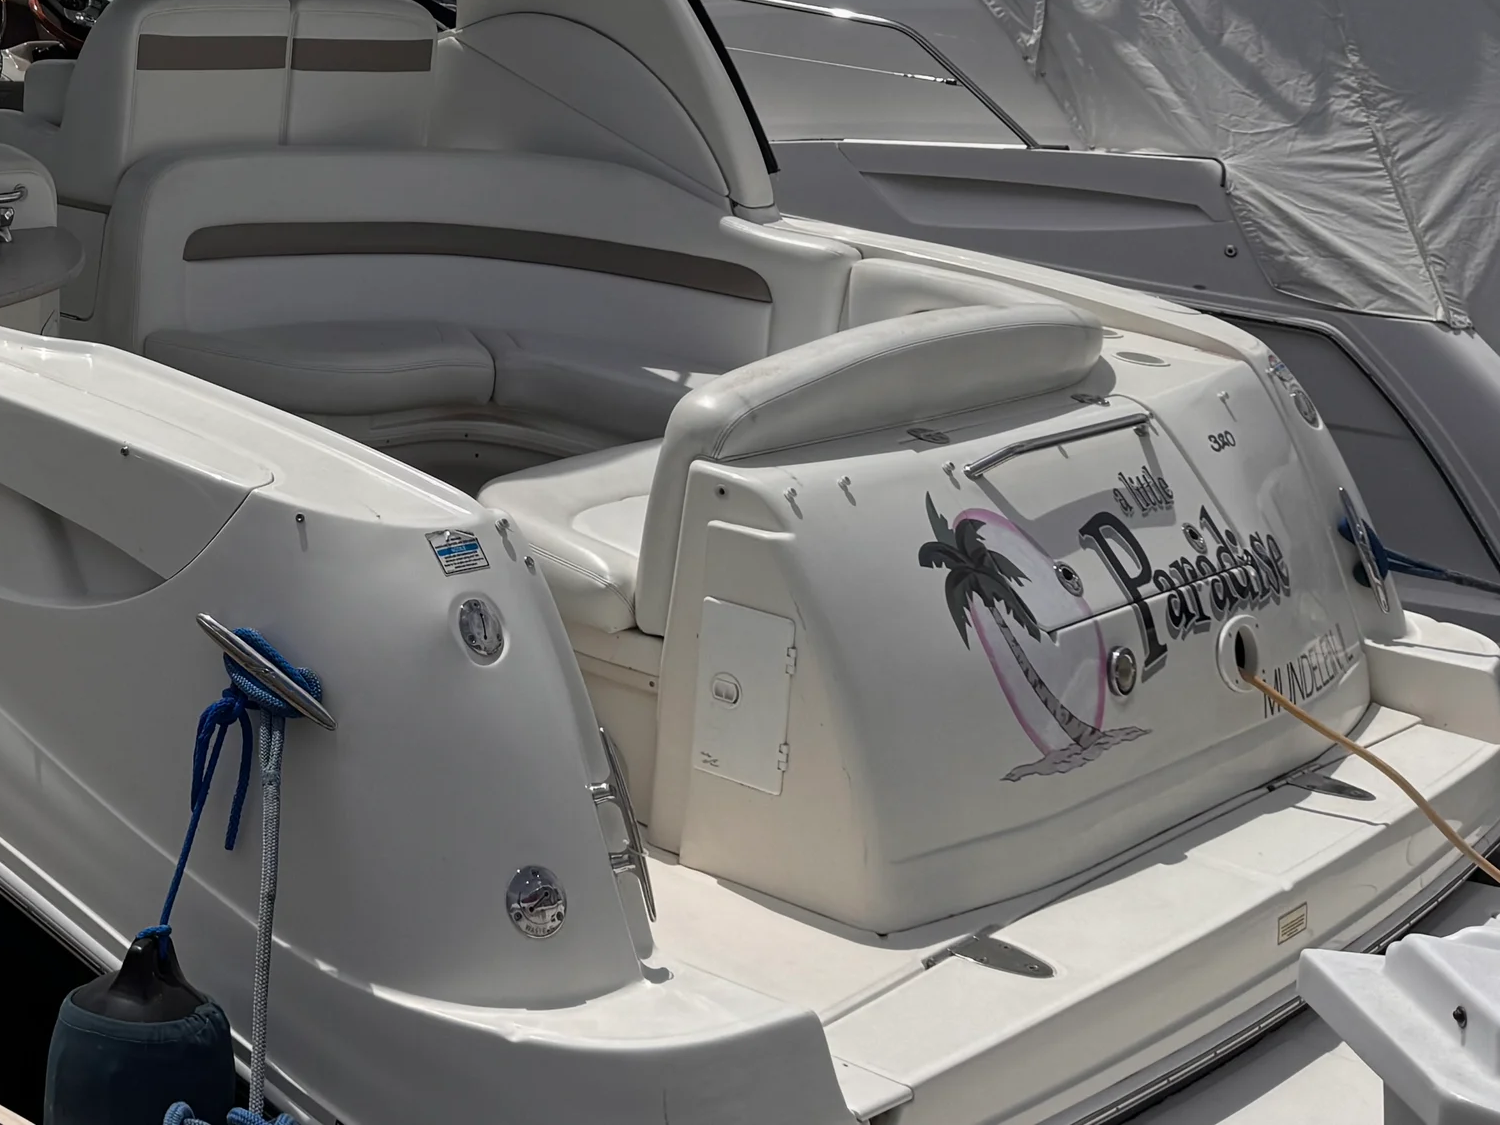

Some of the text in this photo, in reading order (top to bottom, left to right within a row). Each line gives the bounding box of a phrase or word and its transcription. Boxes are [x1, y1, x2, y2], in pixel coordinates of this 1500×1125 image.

[1113, 465, 1174, 517] a little
[1078, 505, 1291, 683] Paradise
